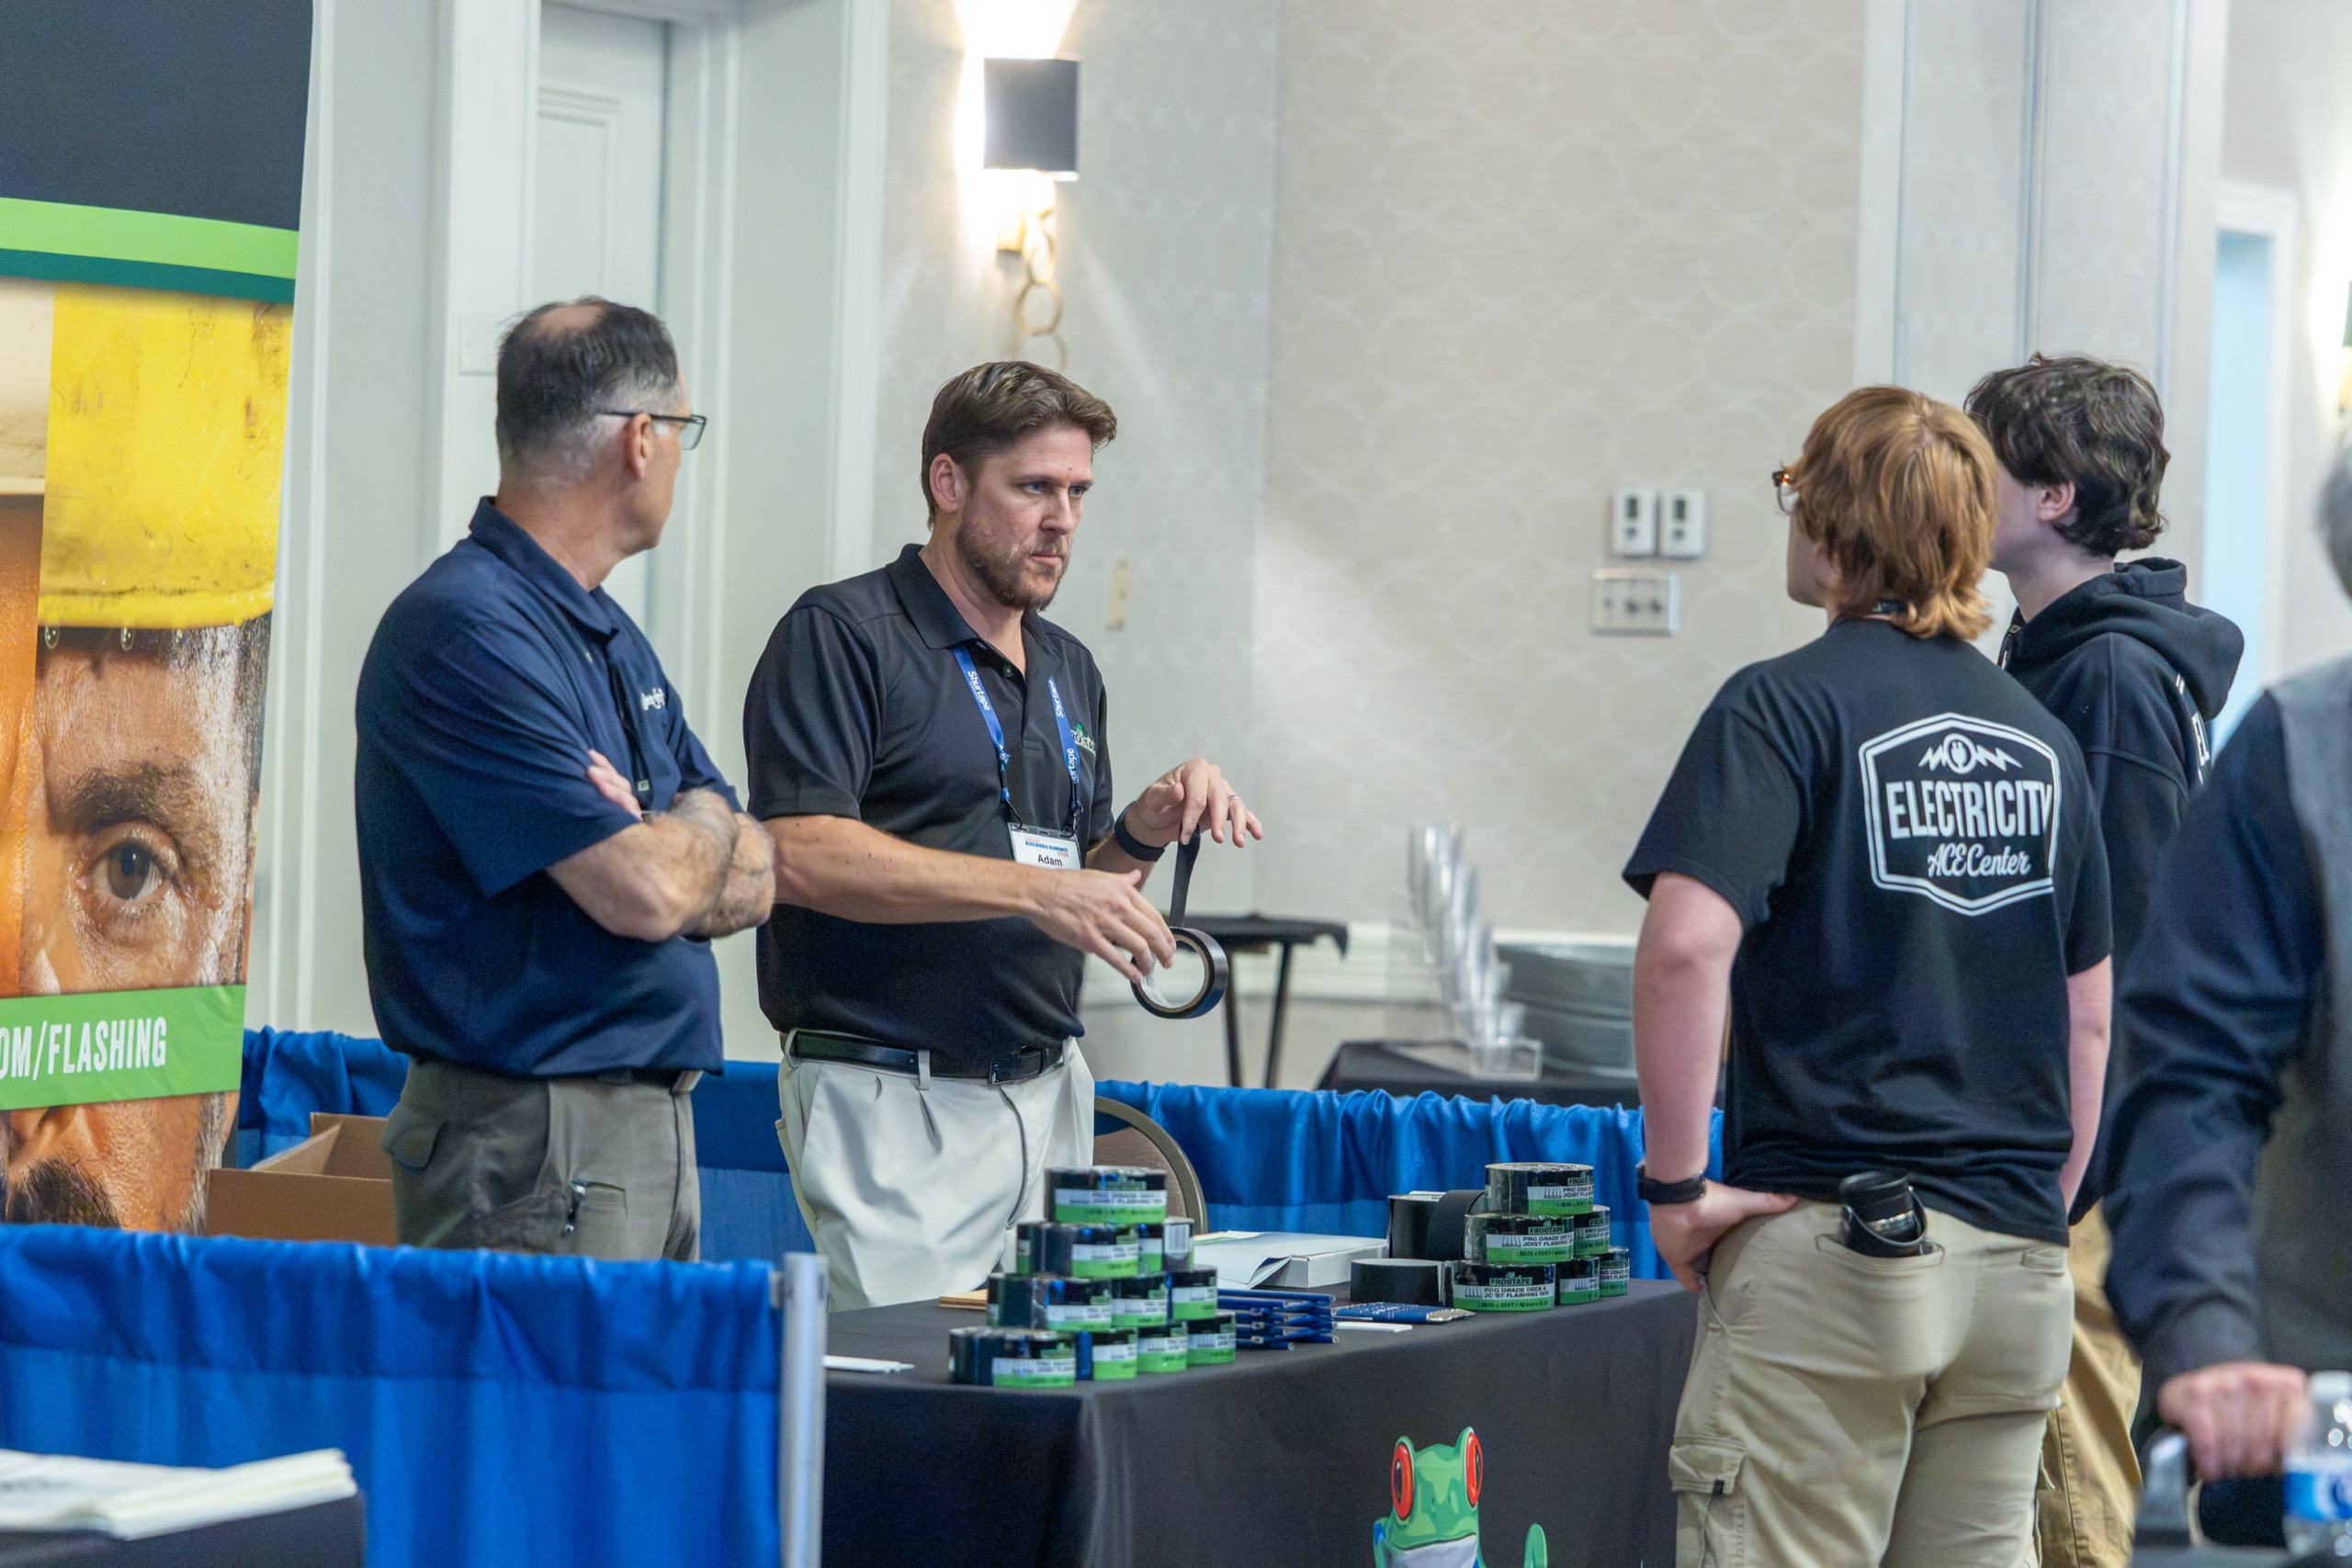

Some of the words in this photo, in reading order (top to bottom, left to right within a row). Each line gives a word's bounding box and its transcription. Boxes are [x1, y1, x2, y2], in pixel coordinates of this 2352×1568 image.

[967, 671, 991, 711] Shurtape
[1067, 748, 1078, 782] urtape
[1885, 780, 2052, 840] ELECTRICITY
[1024, 840, 1048, 850] BUILDERS
[1037, 853, 1063, 867] Adam
